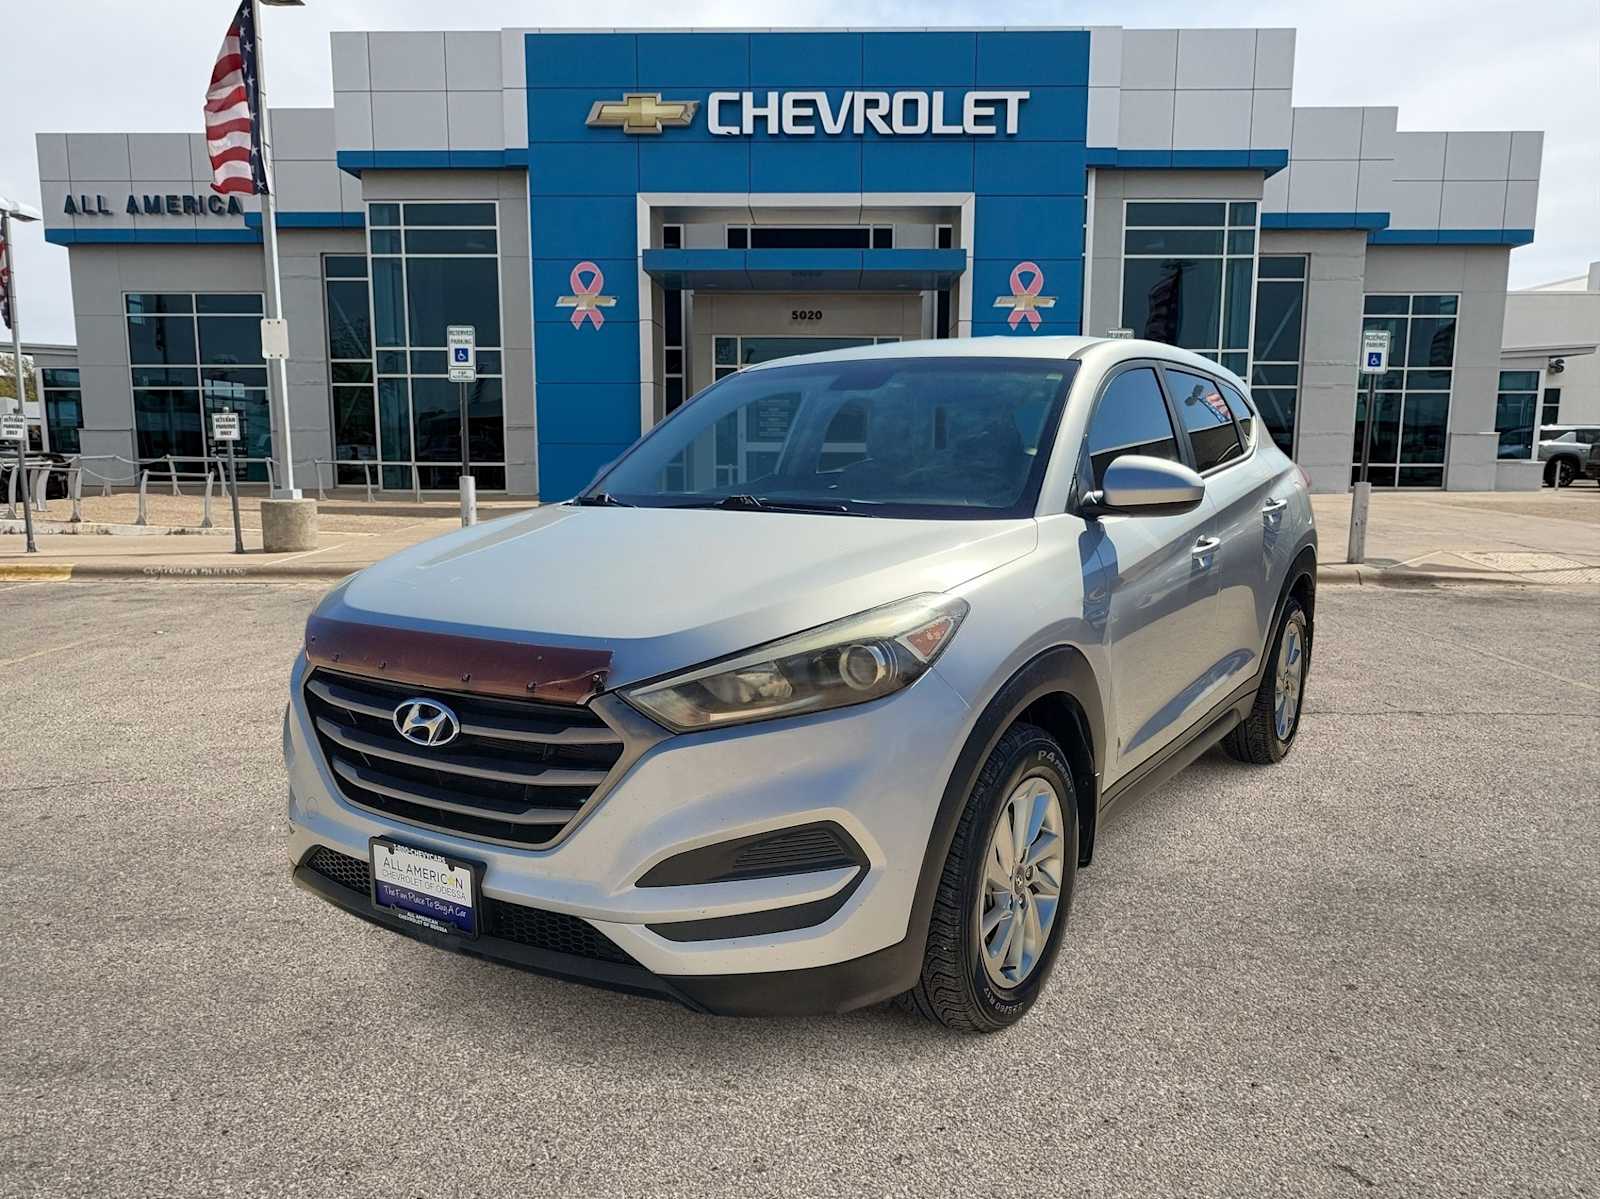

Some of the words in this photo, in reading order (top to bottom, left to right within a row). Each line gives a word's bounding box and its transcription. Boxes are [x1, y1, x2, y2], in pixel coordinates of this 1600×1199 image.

[708, 91, 1030, 135] CHEVROLET
[64, 195, 112, 215] ALL
[126, 194, 244, 215] AMERICA
[792, 310, 822, 320] 5020
[383, 869, 423, 886] CHEVROLET
[425, 881, 435, 890] OF
[436, 885, 467, 902] ODESSA
[384, 857, 403, 872] ALL
[406, 863, 463, 889] AMERICN
[384, 885, 395, 897] The
[408, 891, 425, 905] Place
[425, 897, 434, 908] To
[455, 907, 467, 918] Car
